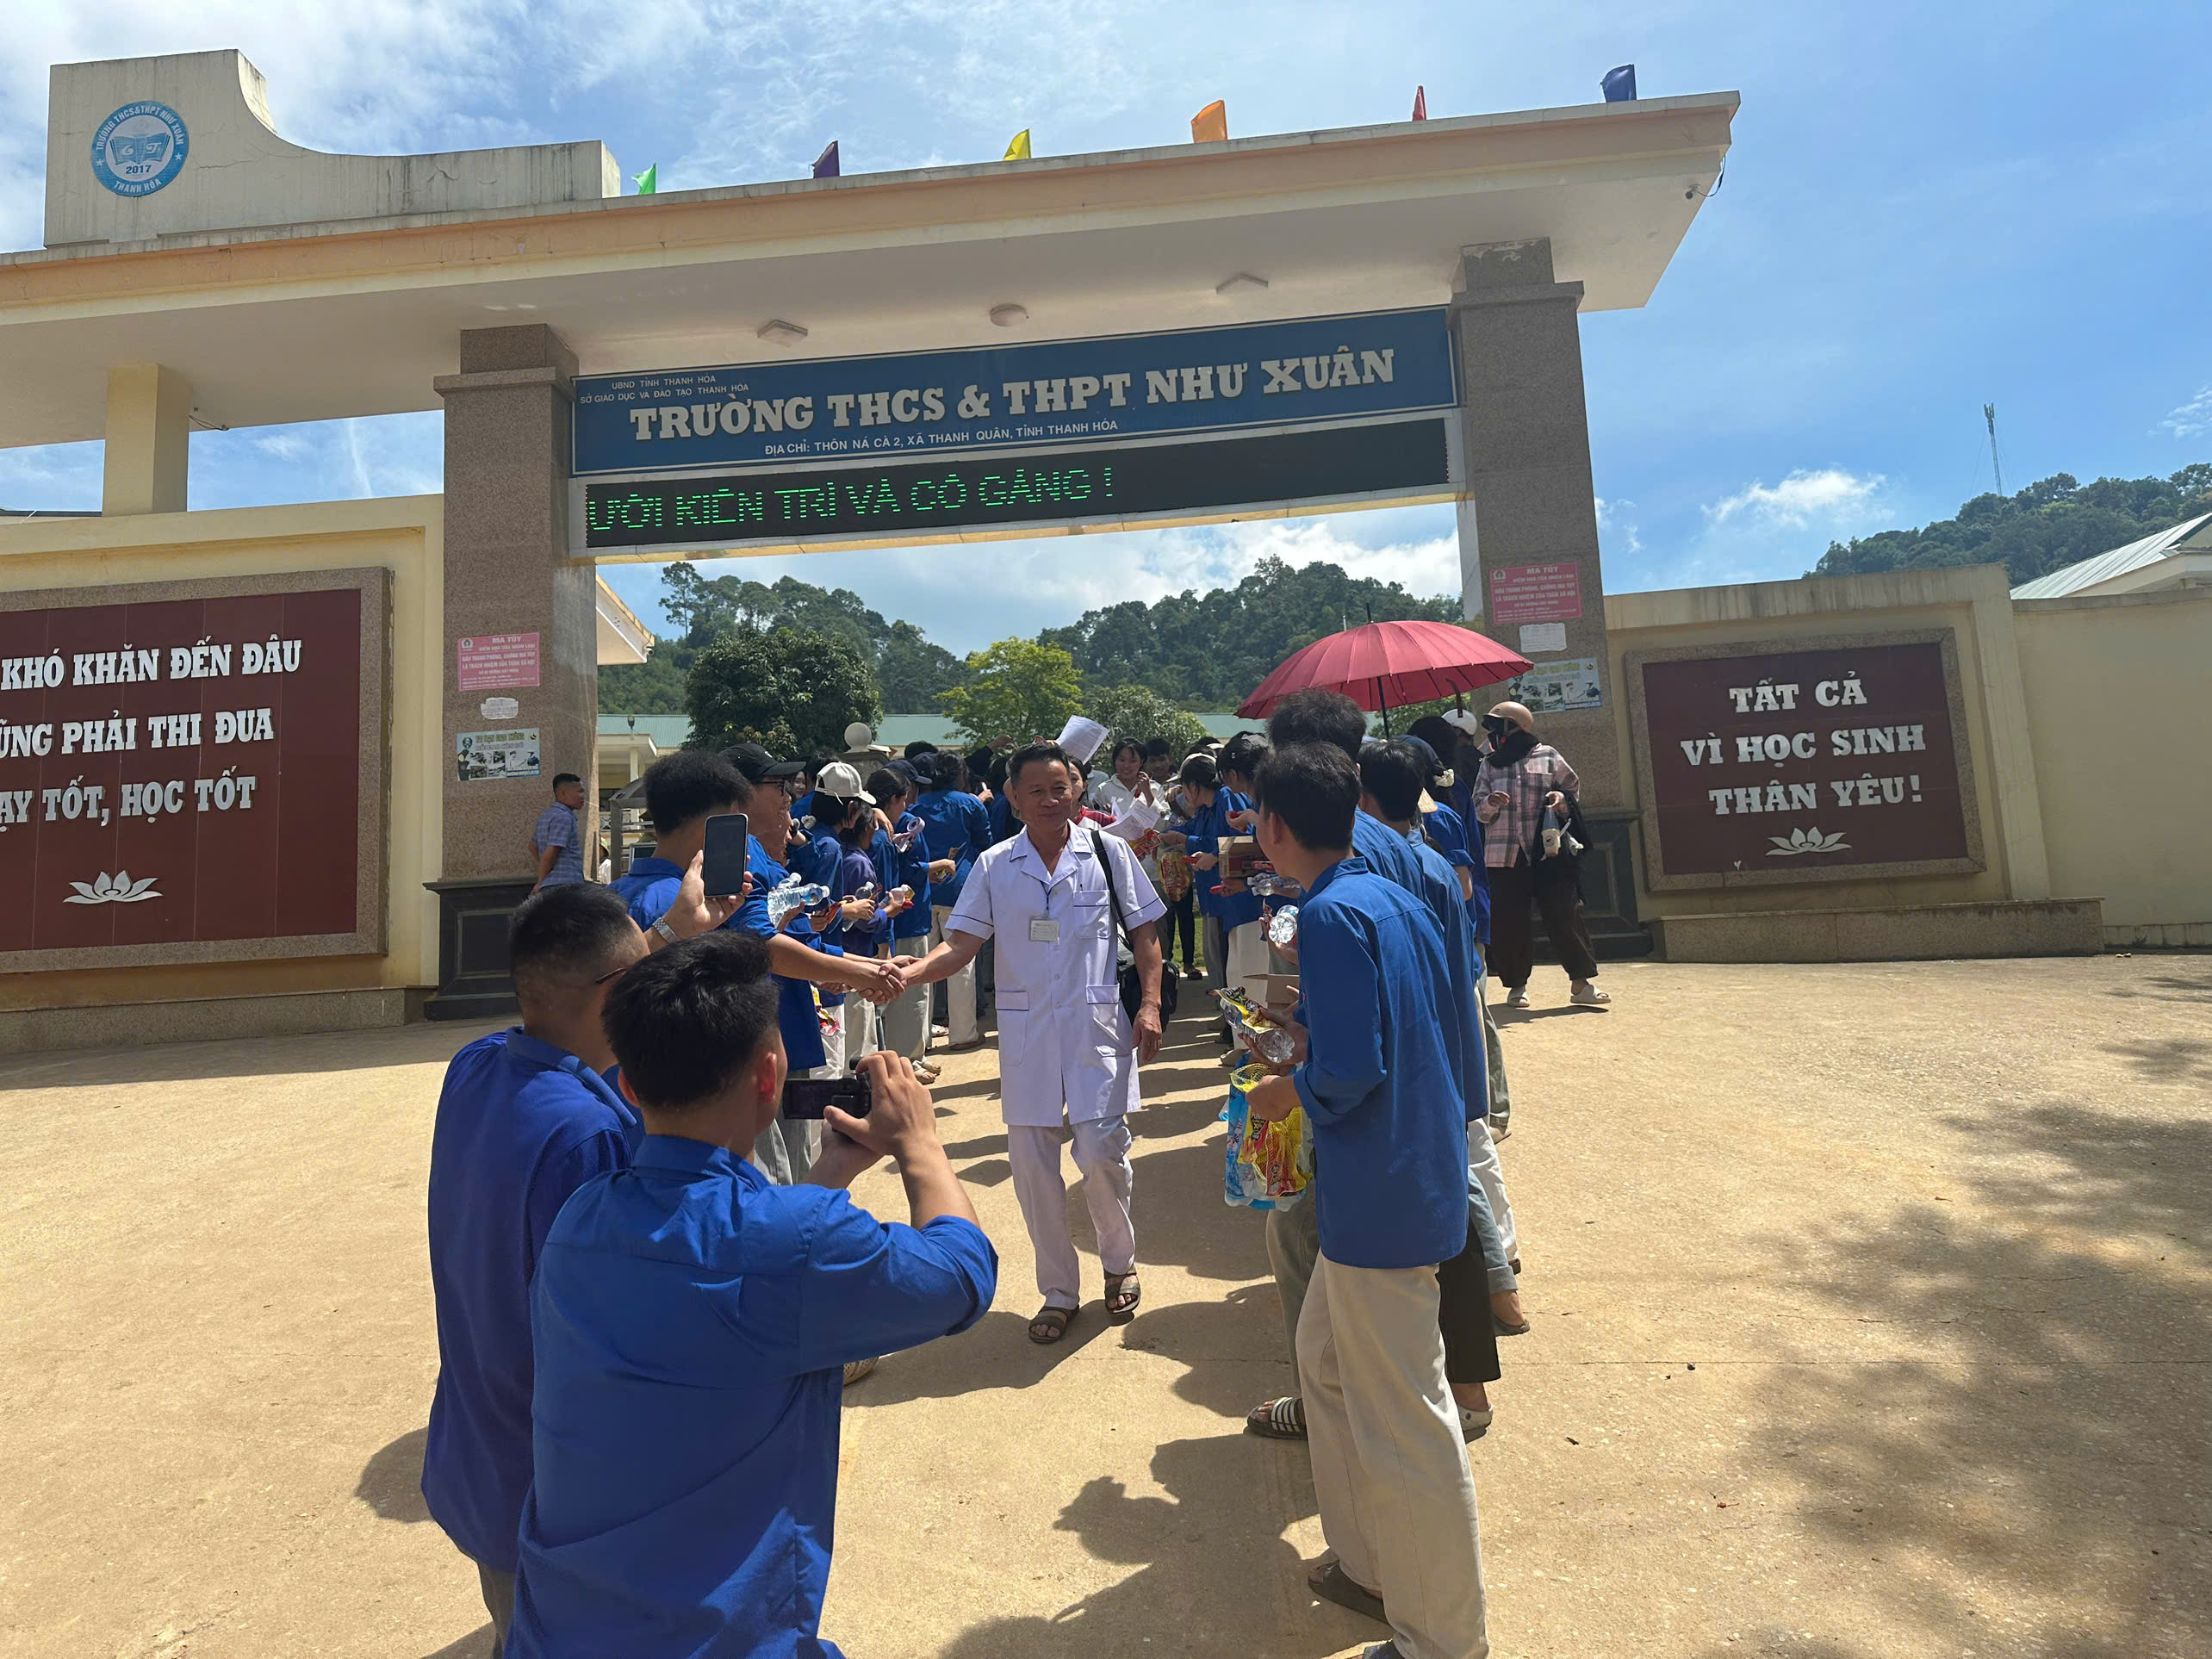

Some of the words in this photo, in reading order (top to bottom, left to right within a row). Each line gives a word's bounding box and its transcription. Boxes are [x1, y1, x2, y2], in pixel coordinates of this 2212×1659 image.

[115, 181, 142, 193] THANH
[126, 165, 152, 174] 2017
[612, 381, 635, 390] UBND
[664, 377, 693, 386] THANH
[630, 393, 814, 441] TRƯỜNG
[827, 387, 946, 427] THCS
[958, 384, 990, 419] &
[1003, 373, 1131, 414] THPT
[1146, 362, 1248, 405] NHƯ
[1260, 345, 1395, 395] XUÂN
[698, 385, 727, 395] THANH
[765, 442, 785, 457] ĐỊA
[786, 438, 810, 453] CHỈ:
[814, 438, 848, 452] THÔN
[853, 436, 869, 449] NÁ
[873, 435, 891, 448] CÀ
[893, 437, 904, 448] 2,
[907, 432, 924, 445] XÃ
[929, 432, 969, 444] THANH
[976, 427, 1014, 441] QUÂN,
[1016, 424, 1043, 438] TỈNH
[1047, 423, 1089, 435] THANH
[1092, 418, 1118, 431] HÓA
[1103, 467, 1114, 497] !
[1, 648, 65, 691] KHÓ
[72, 643, 160, 686] KHĂN
[170, 635, 233, 680] ĐẾN
[242, 633, 302, 674] ĐÂU
[1729, 676, 1799, 714] TẤT
[1815, 670, 1867, 708] CẢ
[61, 709, 137, 755] PHẢI
[147, 712, 202, 749] THI
[214, 707, 275, 744] ĐUA
[1680, 731, 1724, 766] VÌ
[1735, 731, 1817, 768] HỌC
[1830, 724, 1926, 756] SINH
[42, 774, 111, 827] TỐT,
[121, 780, 185, 824] HỌC
[194, 765, 257, 812] TỐT
[1708, 779, 1817, 816] THÂN
[1830, 772, 1923, 807] YÊU!
